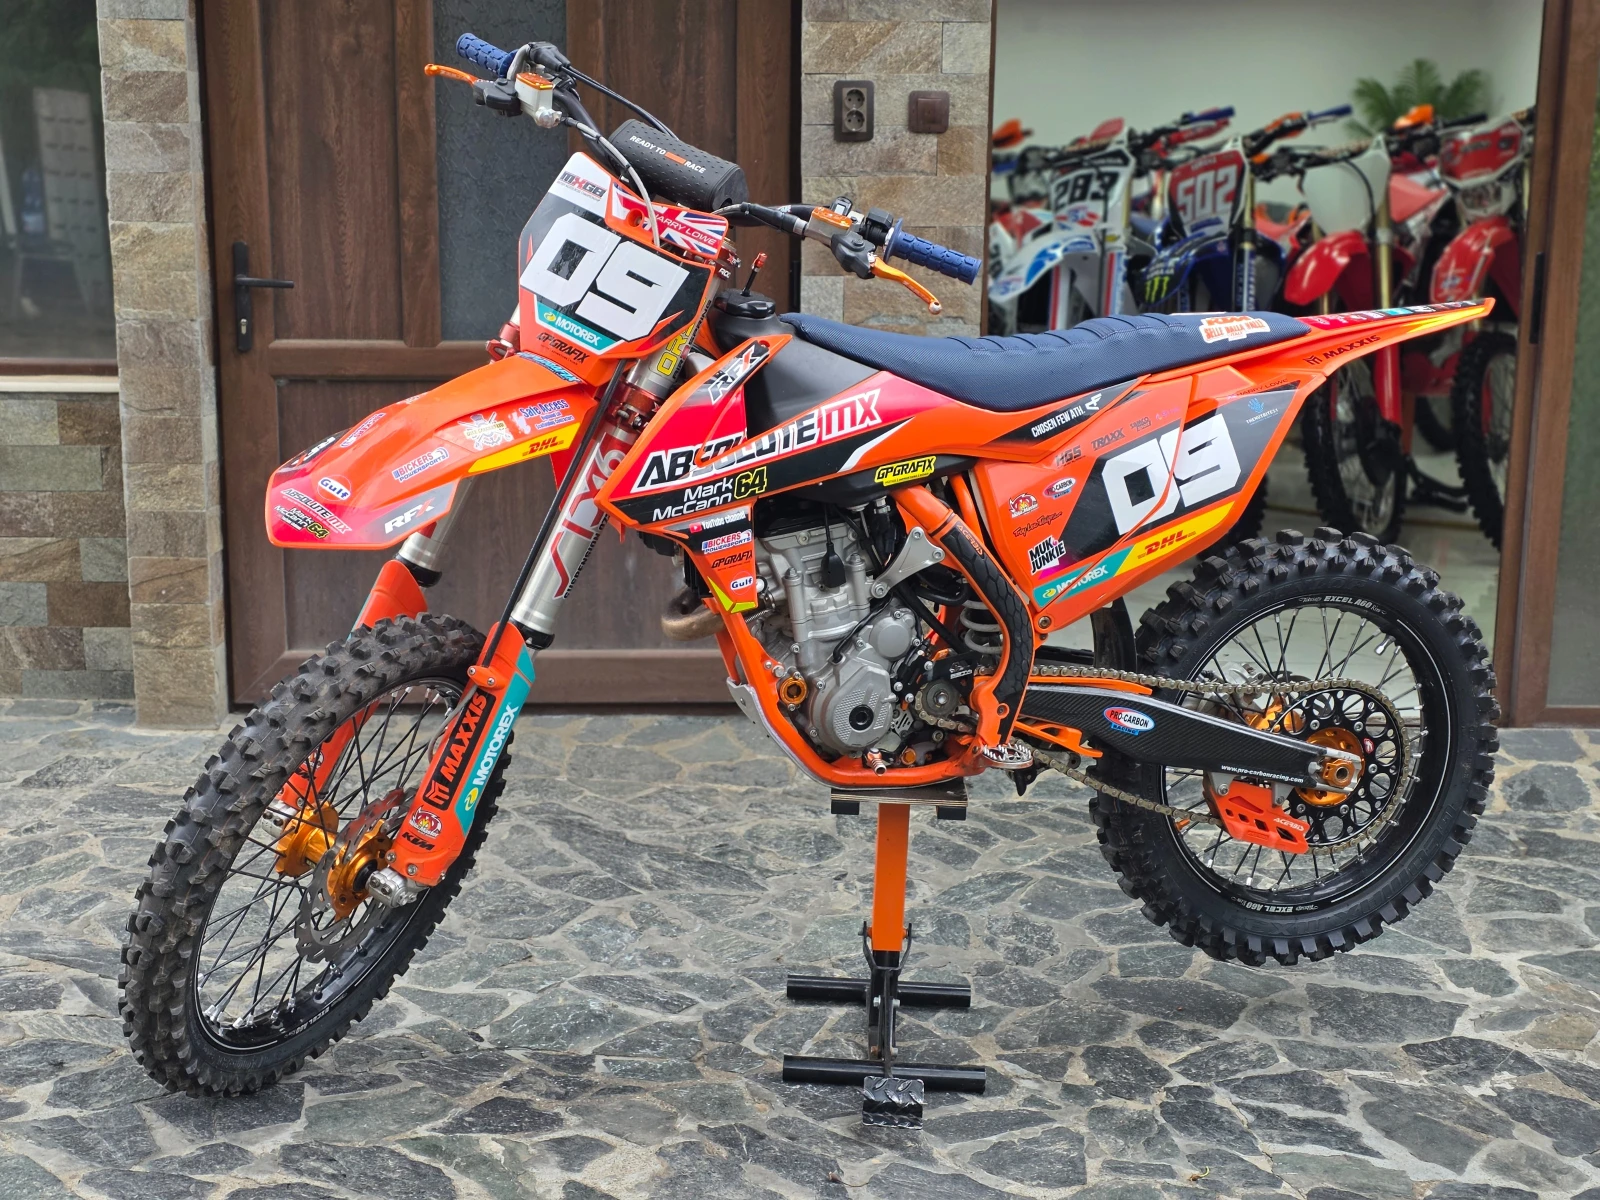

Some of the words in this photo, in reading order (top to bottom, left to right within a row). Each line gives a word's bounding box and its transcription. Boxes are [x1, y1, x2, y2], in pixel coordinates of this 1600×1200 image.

[629, 135, 656, 150] READY
[655, 147, 666, 155] TO
[684, 161, 706, 174] RACE
[560, 171, 607, 198] MXGB
[1176, 164, 1238, 224] 502
[685, 227, 717, 245] LOWE
[520, 212, 690, 343] 09
[555, 317, 602, 346] MOTOREX
[689, 300, 712, 345] SPRING
[1322, 334, 1381, 361] MAXXIS
[1265, 378, 1289, 389] LOWE
[539, 399, 569, 413] Access
[1031, 417, 1058, 438] CHOSEN
[1055, 410, 1071, 426] FEW
[1070, 405, 1086, 420] ATH.
[529, 436, 558, 454] DHL
[1091, 428, 1125, 451] TRAXX
[398, 452, 433, 476] BICKERS
[400, 455, 446, 482] POWERSPORTS
[1055, 445, 1082, 467] HGS
[877, 458, 934, 480] GPGRAFIX
[1101, 413, 1242, 536] 09
[320, 478, 349, 499] Gulf
[683, 477, 734, 502] Mark
[734, 465, 767, 500] 64
[385, 497, 435, 534] RFX
[652, 492, 733, 522] McCann
[307, 522, 330, 539] 64
[701, 518, 725, 530] YouTube
[704, 537, 751, 553] POWERSPORTS
[707, 532, 741, 548] BICKERS
[1028, 537, 1053, 562] MUK
[1144, 530, 1188, 556] DHL
[563, 533, 600, 600] SUSPENSION
[1031, 543, 1065, 574] JUNKIE
[732, 577, 752, 589] Gulf
[1056, 565, 1109, 594] MOTOREX
[1323, 595, 1354, 605] EXCEL
[1110, 710, 1149, 728] PRO-CARBON
[1113, 724, 1137, 734] RACING
[440, 692, 487, 784] MAXXIS
[473, 703, 519, 786] MOTOREX
[1221, 764, 1304, 783] www.pro-carbonracing.com
[402, 831, 435, 851] KTM
[1264, 905, 1293, 913] EXCEL
